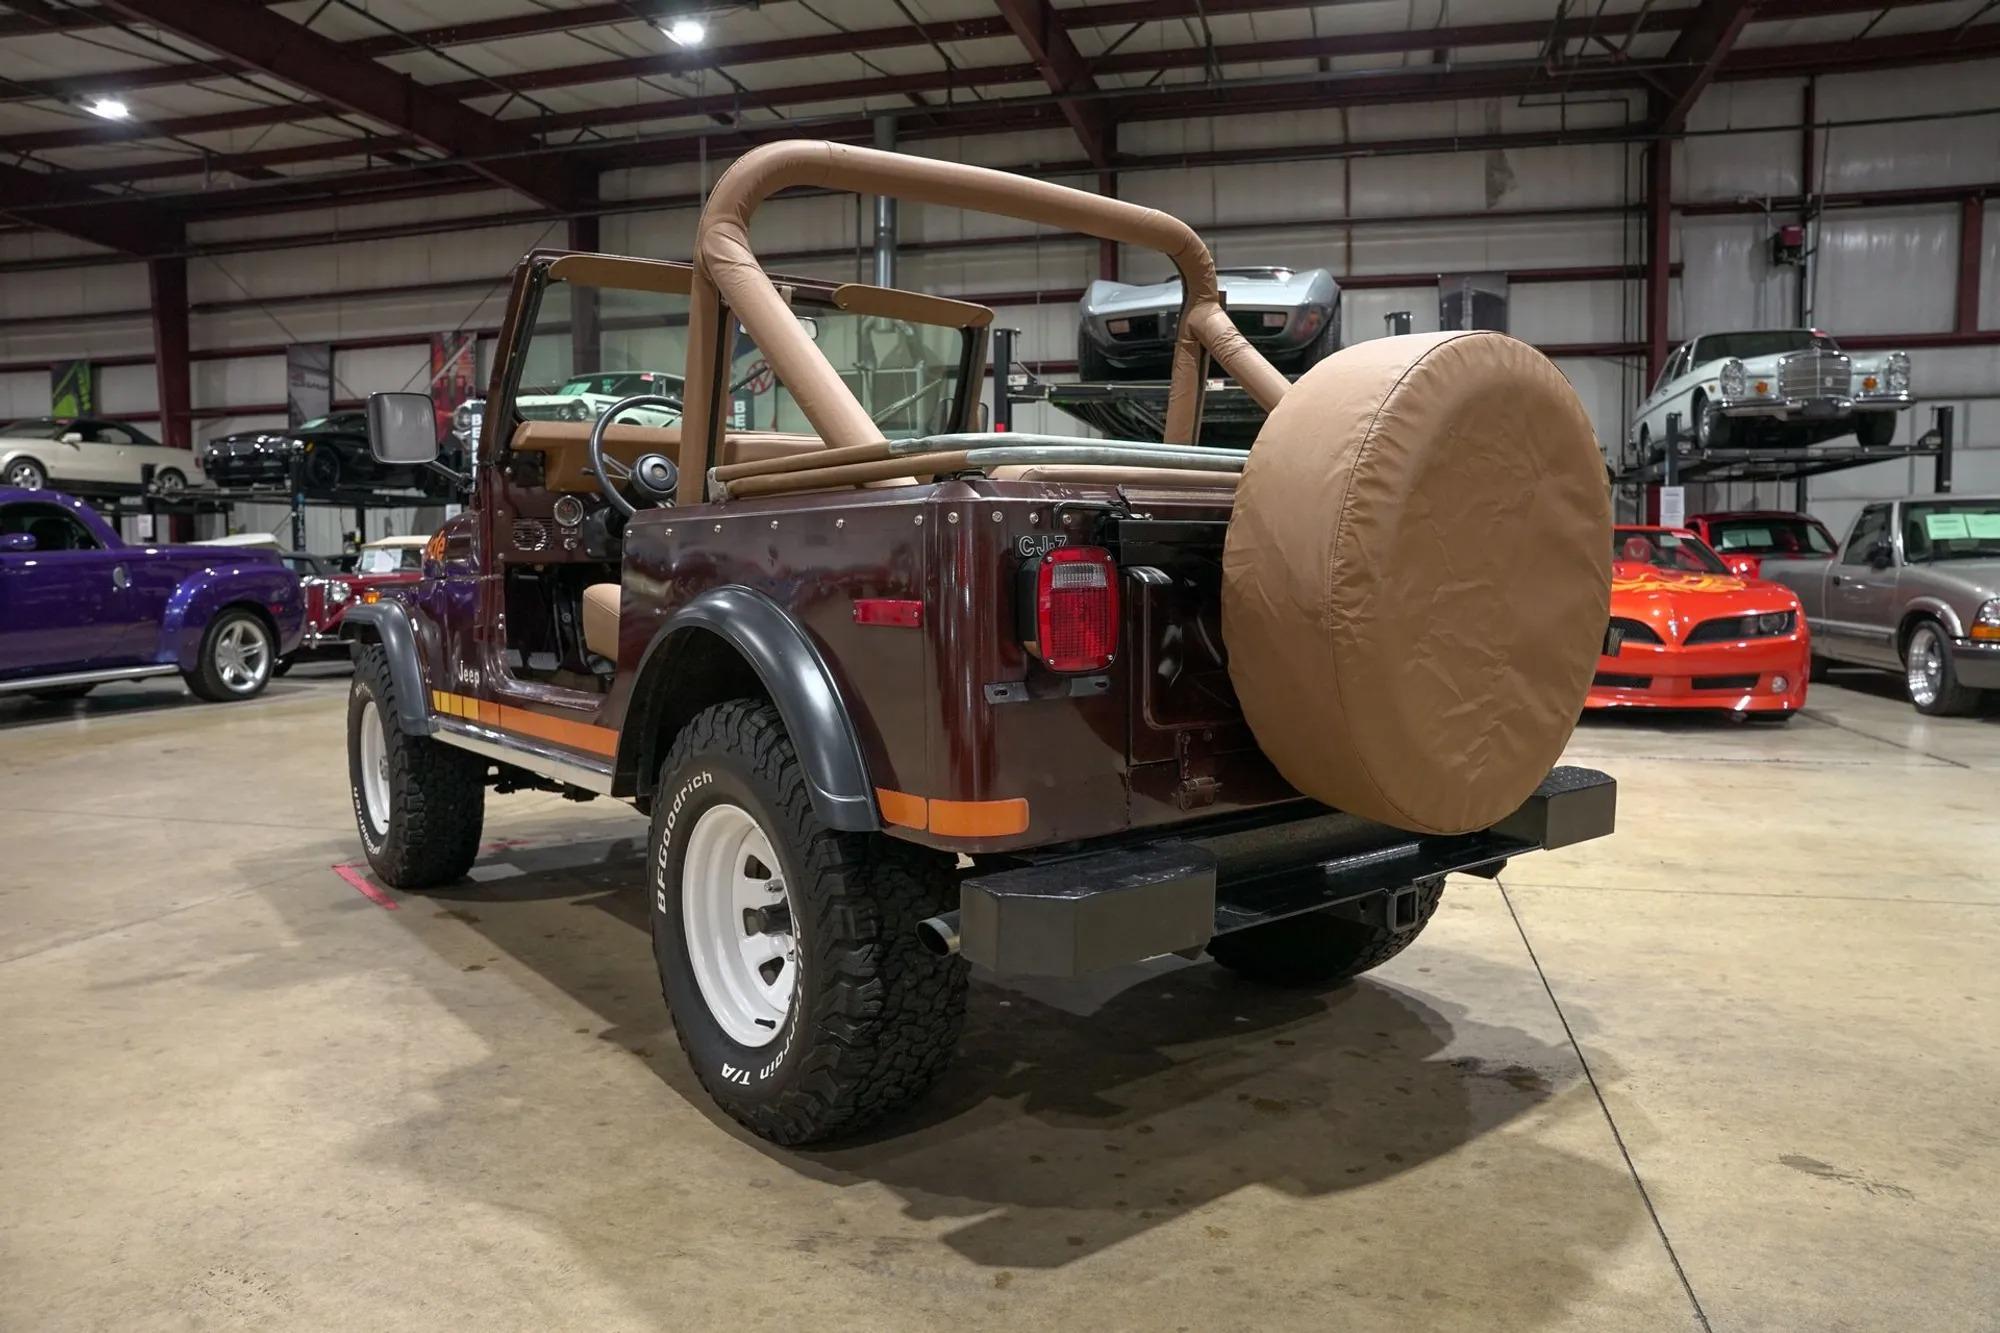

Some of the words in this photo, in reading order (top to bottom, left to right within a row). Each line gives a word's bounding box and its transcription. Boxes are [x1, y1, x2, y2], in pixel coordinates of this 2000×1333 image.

[458, 659, 480, 688] Jeep
[656, 770, 713, 915] BFGoodrich
[721, 1063, 751, 1086] T/A
